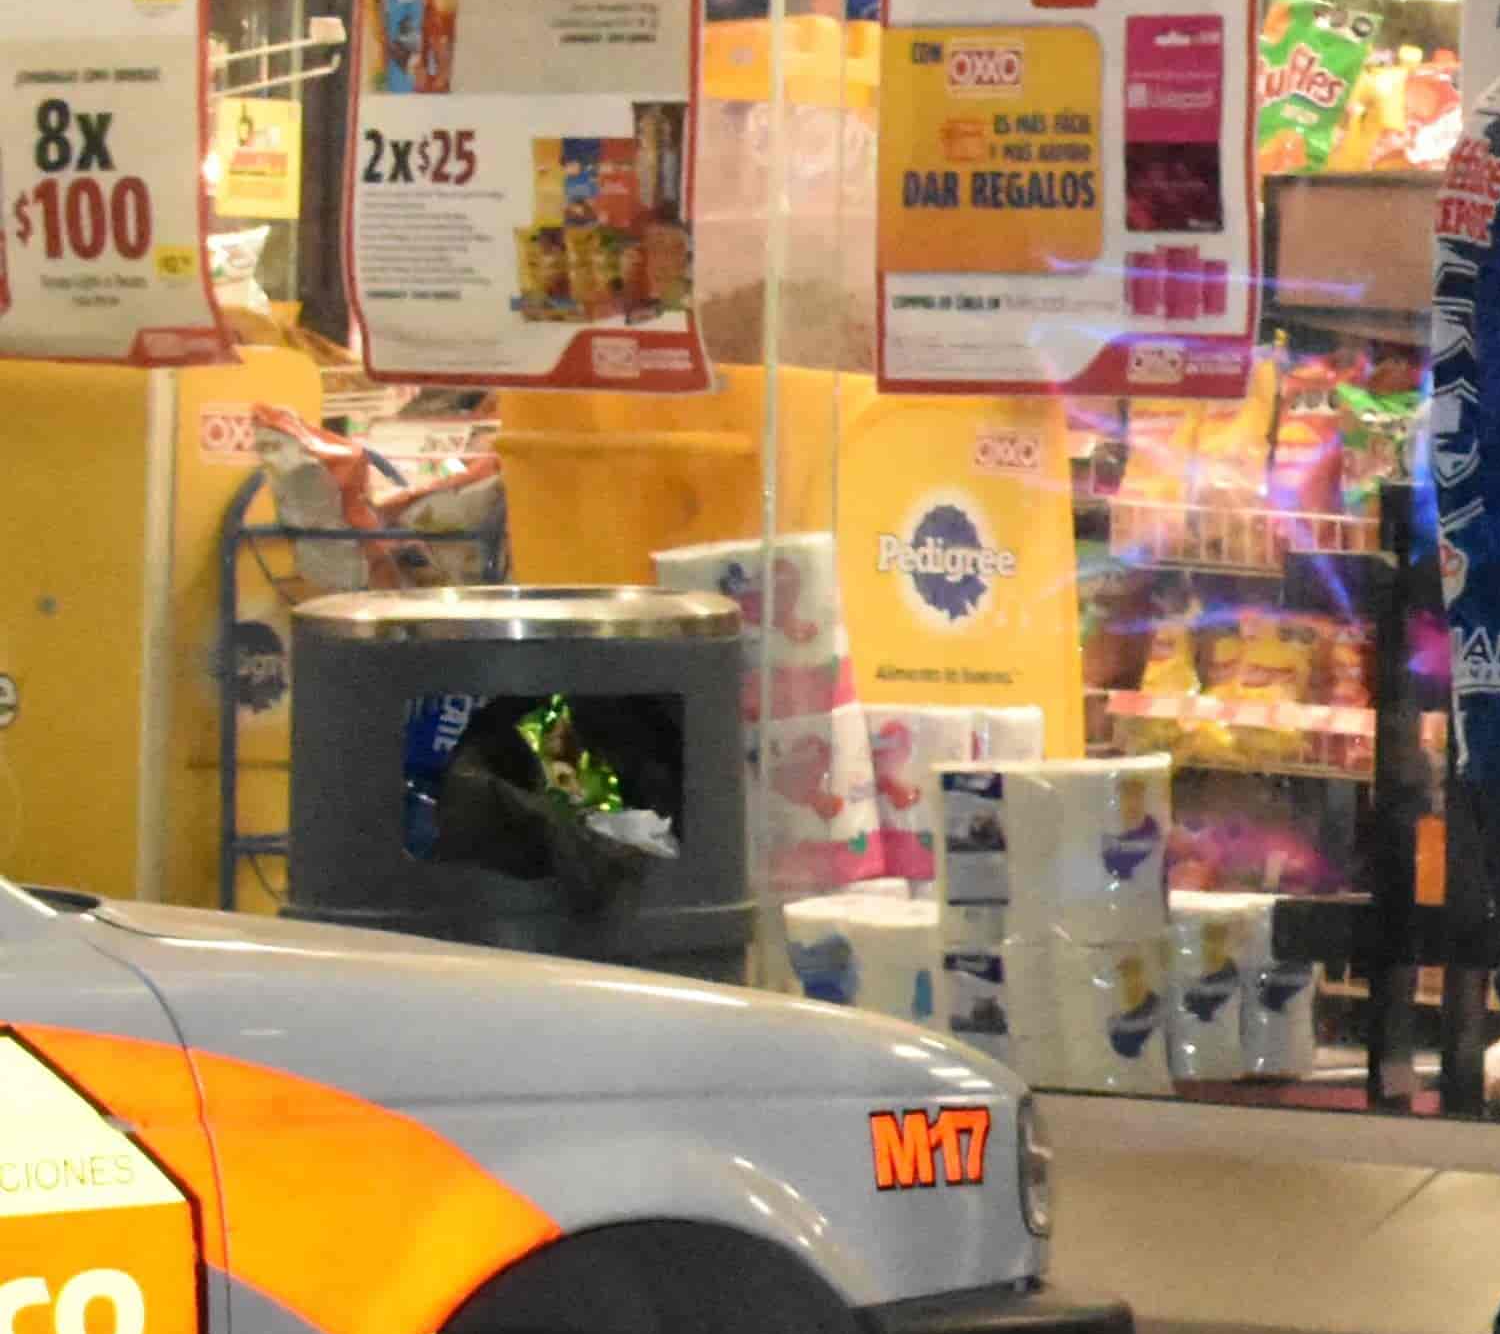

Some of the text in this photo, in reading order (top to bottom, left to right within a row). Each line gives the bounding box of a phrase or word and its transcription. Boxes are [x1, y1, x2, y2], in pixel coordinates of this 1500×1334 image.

[35, 98, 117, 173] 8x
[14, 175, 152, 261] $100
[903, 170, 1097, 209] DAR REGALOS
[876, 534, 1017, 583] Pedigree
